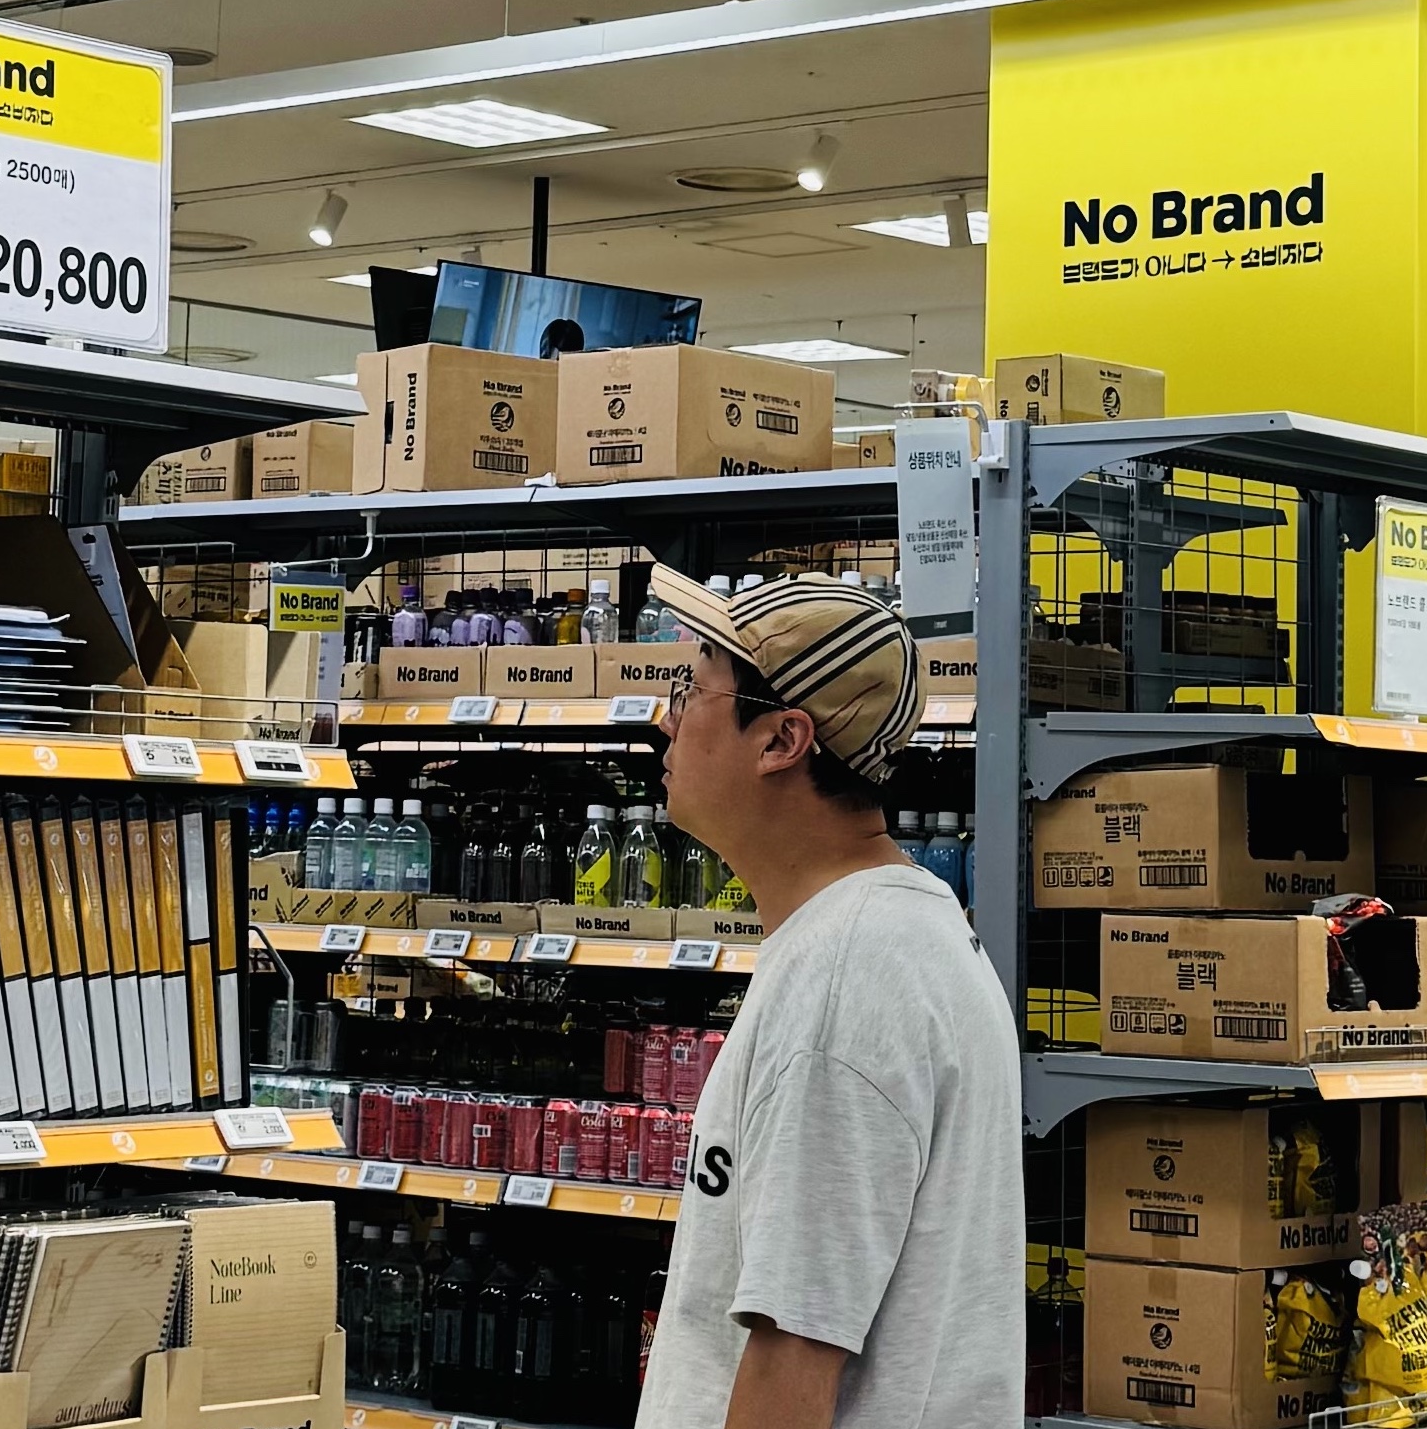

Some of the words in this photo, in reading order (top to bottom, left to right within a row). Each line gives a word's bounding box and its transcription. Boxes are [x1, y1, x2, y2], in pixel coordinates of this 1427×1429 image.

[6, 159, 76, 193] 2500매)
[1063, 196, 1138, 248] No
[1152, 172, 1324, 240] Brand
[1063, 258, 1140, 285] 브랜드가
[1144, 252, 1207, 277] 아니다
[1241, 241, 1323, 270] 소비자다
[1391, 520, 1417, 549] No
[280, 590, 299, 609] No
[301, 590, 340, 612] Brand
[397, 666, 418, 683] No
[419, 666, 460, 683] Brand
[507, 666, 528, 683] No
[529, 666, 573, 684] Brand
[1103, 814, 1142, 844] 블랙
[1110, 928, 1129, 943] No
[1131, 929, 1169, 943] Brand
[1176, 960, 1218, 992] 블랙
[210, 1254, 276, 1280] NoteBook
[210, 1284, 242, 1305] Line
